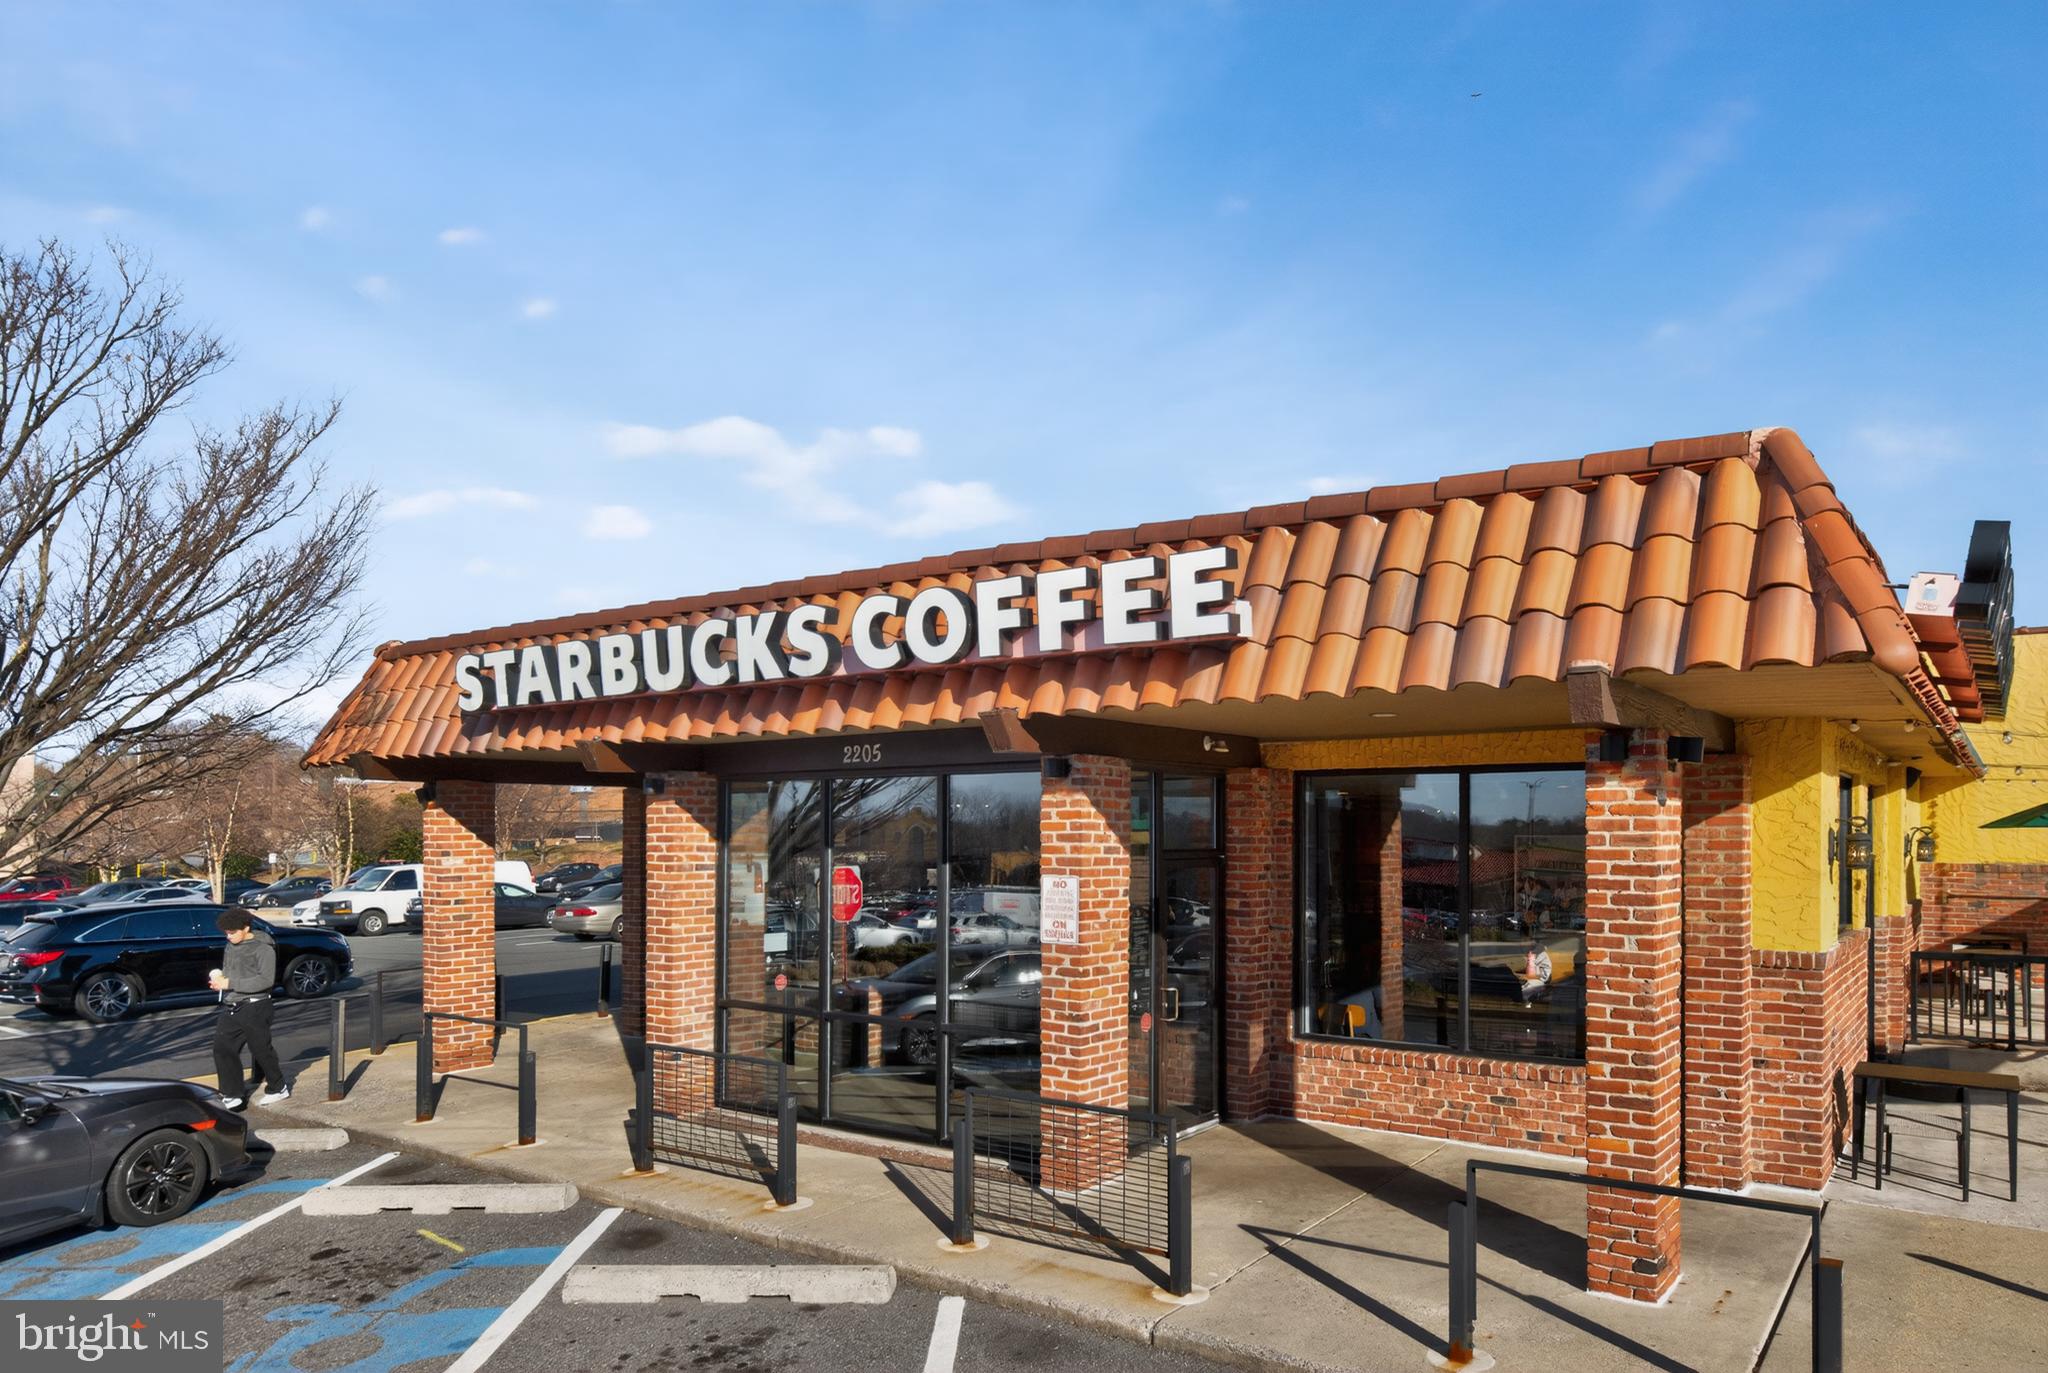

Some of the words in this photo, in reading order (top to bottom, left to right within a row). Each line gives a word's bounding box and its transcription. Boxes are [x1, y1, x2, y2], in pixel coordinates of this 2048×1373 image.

[455, 604, 829, 712] STARBUCKS
[851, 546, 1234, 670] COFFEE
[843, 743, 882, 763] 2205
[1052, 880, 1067, 889] NO
